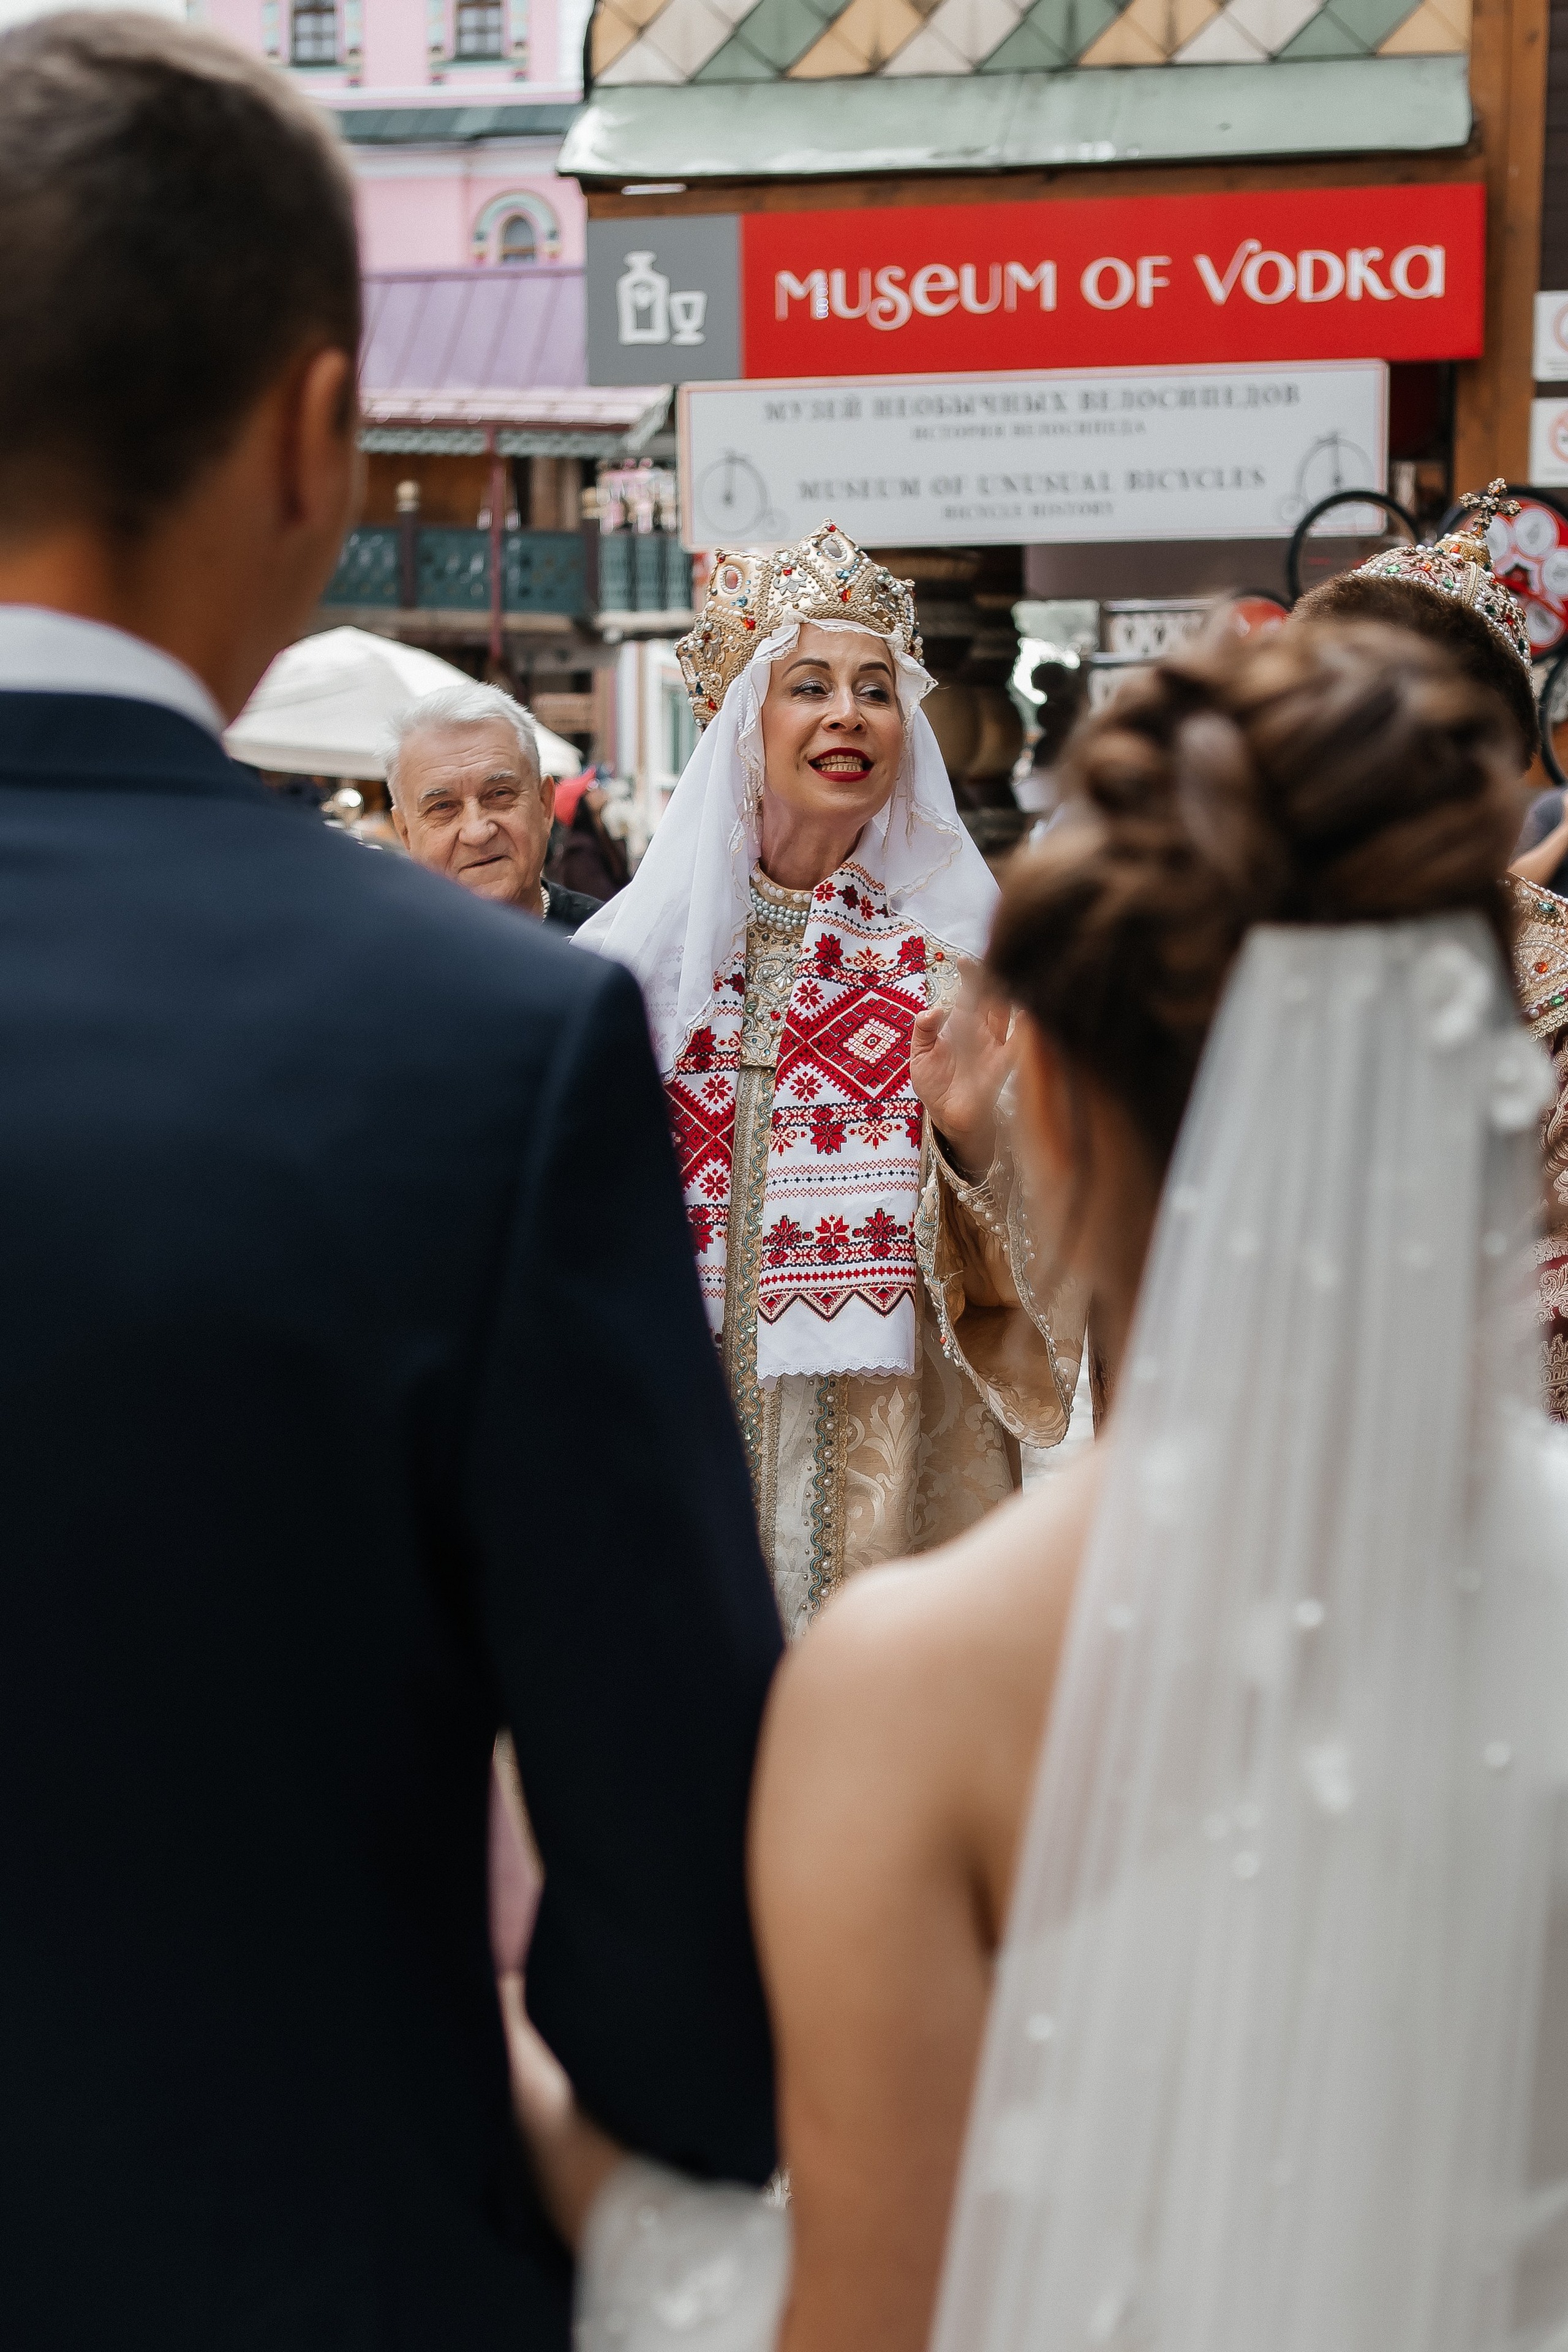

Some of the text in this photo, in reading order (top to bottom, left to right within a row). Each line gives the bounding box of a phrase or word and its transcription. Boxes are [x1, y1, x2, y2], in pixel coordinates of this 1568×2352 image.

[1080, 256, 1173, 311] OF
[766, 384, 1300, 420] МУЗЕЙ НЕОБЫЧНЫХ ВЕЛОСИПЕДОВ
[799, 466, 1265, 500] MUSEUM OF UNUSUAL BICYCLES
